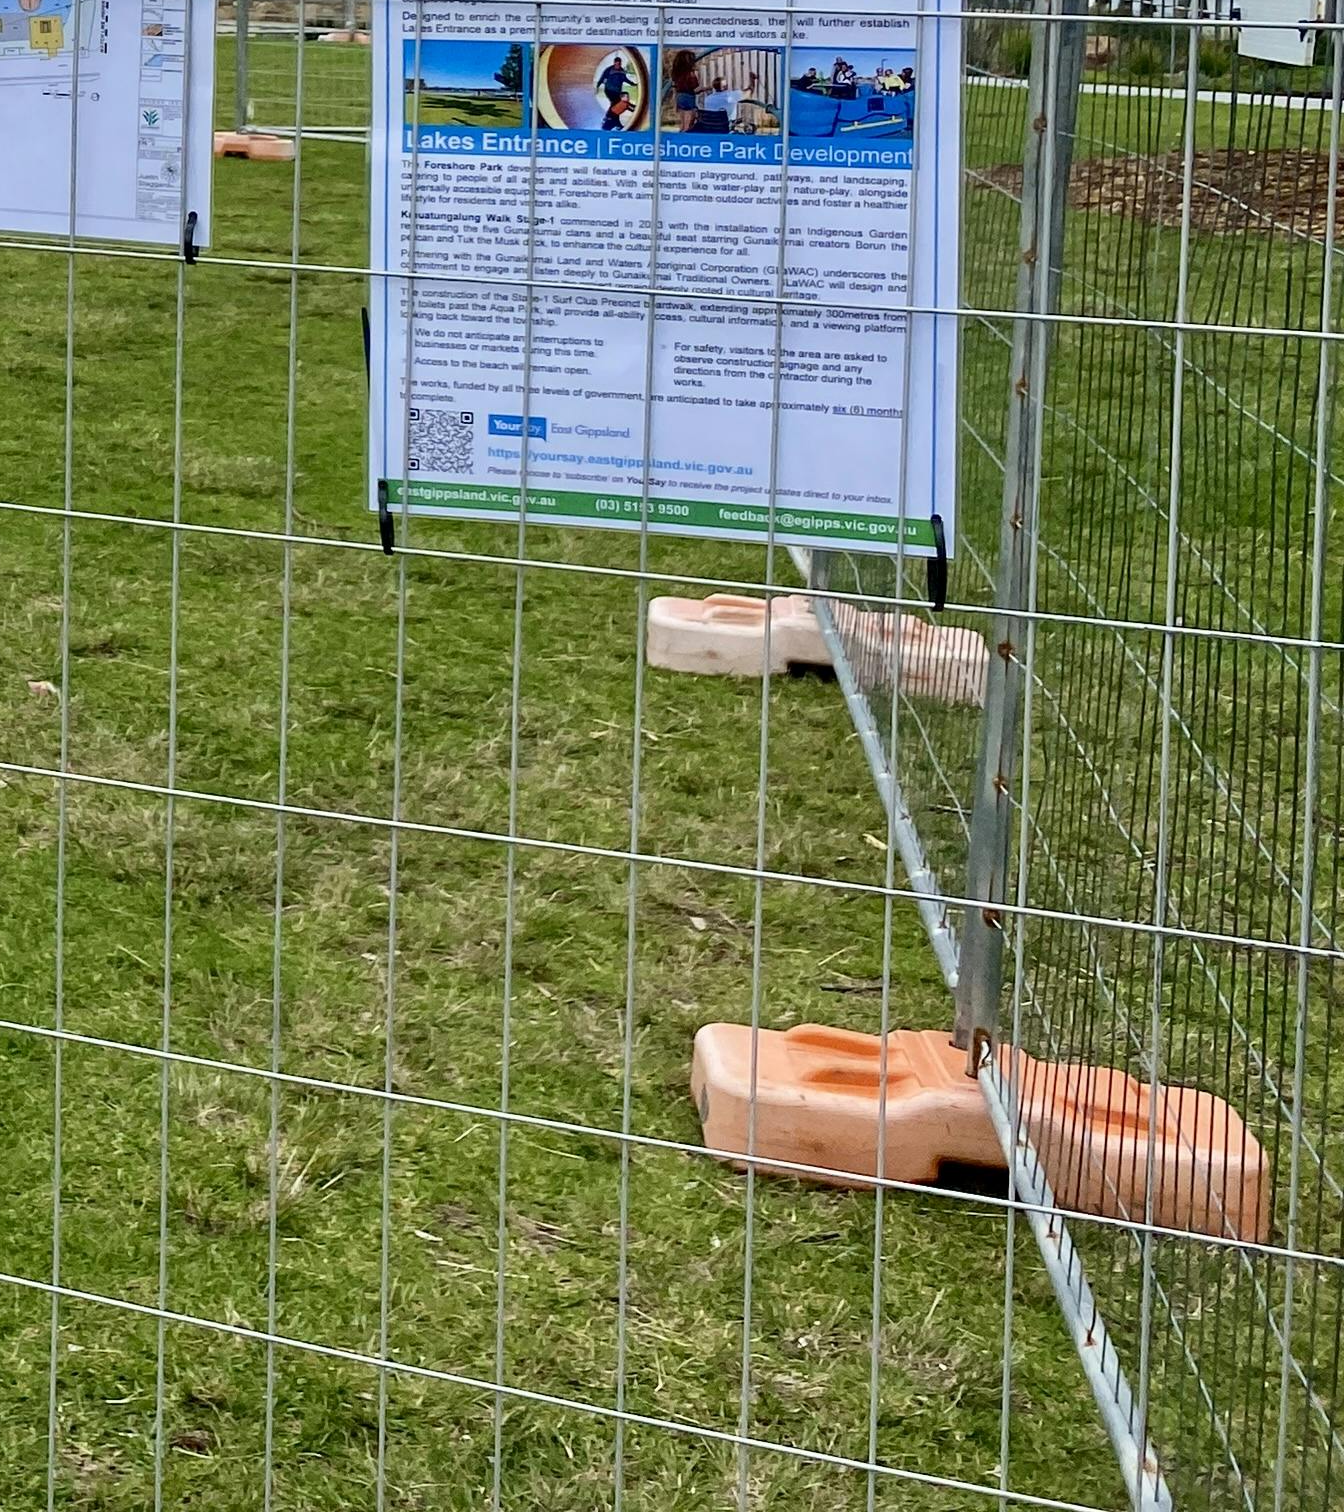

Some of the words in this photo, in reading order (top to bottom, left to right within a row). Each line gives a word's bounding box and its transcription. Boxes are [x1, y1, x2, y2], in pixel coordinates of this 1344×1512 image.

[406, 130, 474, 151] Lakes
[483, 133, 588, 155] Entrance
[608, 138, 712, 158] Foreshore
[719, 141, 766, 160] Park
[424, 160, 475, 170] Foreshore
[479, 162, 503, 171] Park
[572, 165, 588, 174] will
[592, 166, 627, 176] feature
[698, 170, 758, 182] playground,
[819, 174, 838, 183] and
[843, 175, 907, 187] landscaping,
[674, 342, 691, 351] For
[693, 343, 726, 355] safety,
[728, 345, 764, 355] visitors
[798, 351, 821, 359] area
[823, 352, 841, 360] are
[844, 351, 874, 362] asked
[876, 353, 887, 362] to
[413, 356, 448, 366] Access
[450, 358, 459, 367] to
[462, 359, 477, 368] the
[479, 360, 509, 370] beach
[564, 367, 591, 377] open.
[673, 353, 713, 364] observe
[821, 362, 841, 372] and
[843, 365, 864, 375] any
[673, 365, 721, 377] directions
[724, 368, 746, 378] from
[749, 370, 765, 379] the
[820, 374, 852, 387] during
[855, 376, 872, 386] the
[673, 377, 705, 387] works.
[575, 424, 630, 439] Gippsland
[595, 499, 620, 513] (03)
[658, 503, 689, 516] 9500
